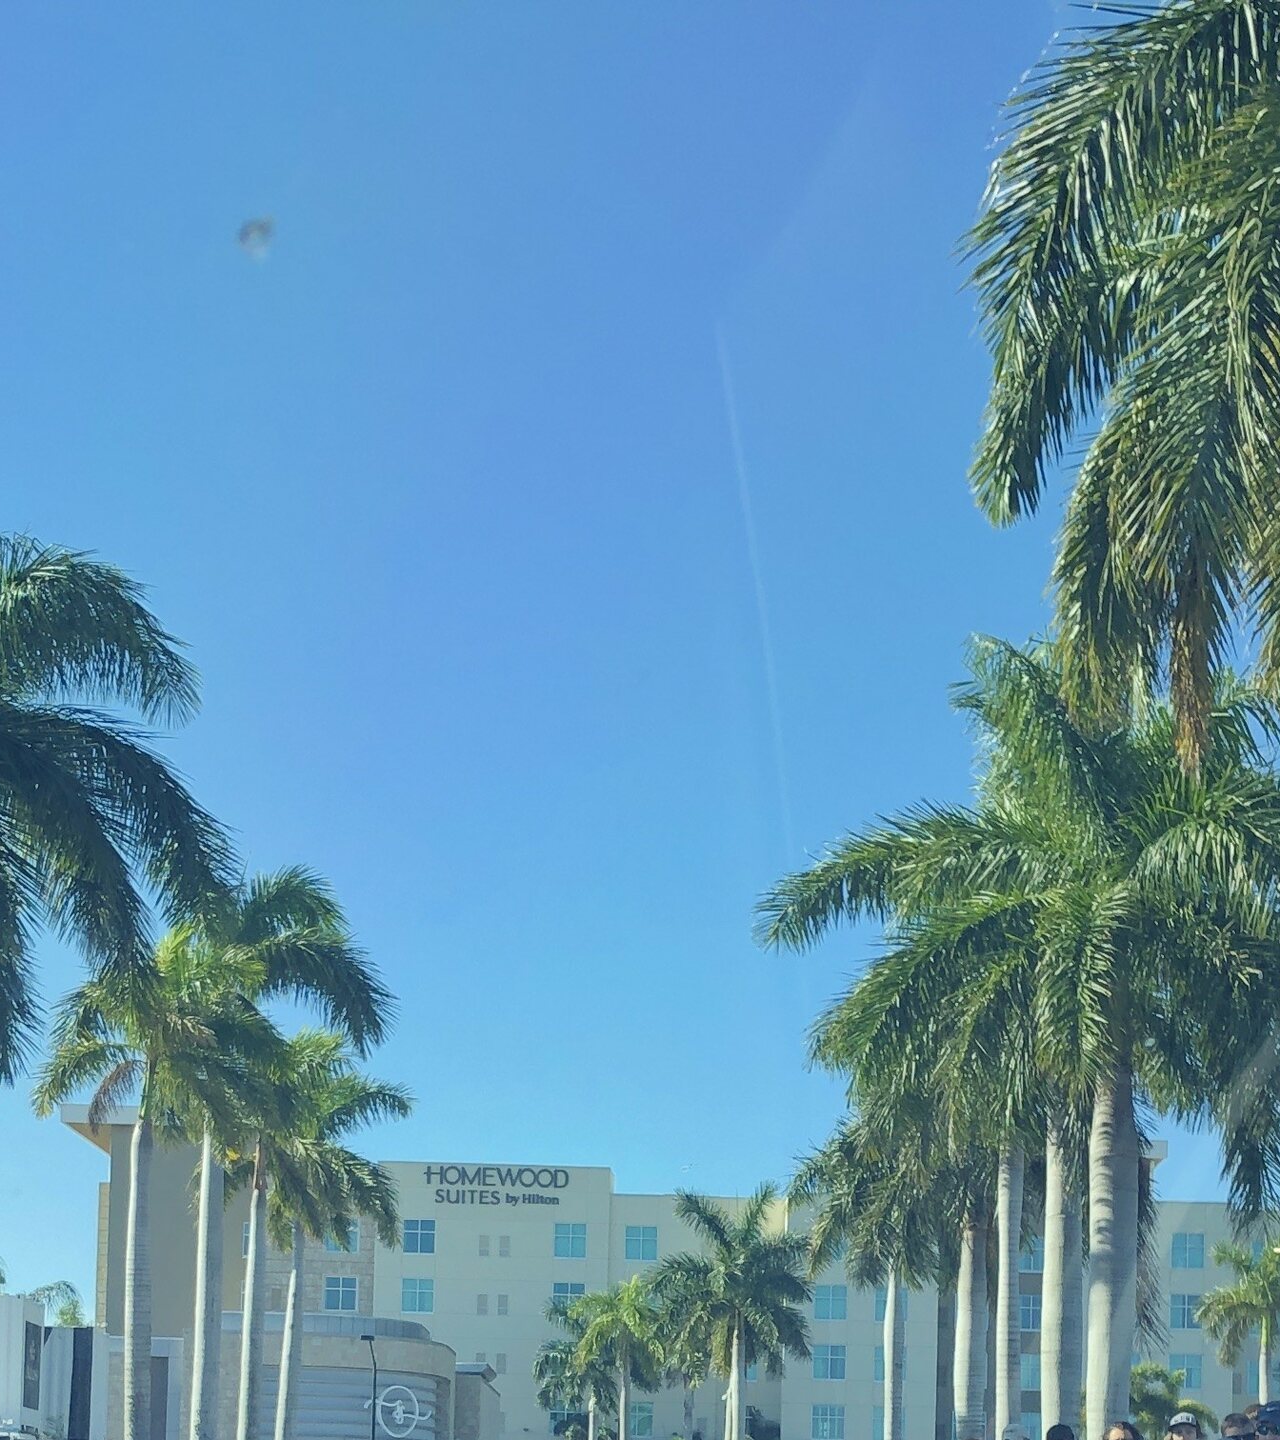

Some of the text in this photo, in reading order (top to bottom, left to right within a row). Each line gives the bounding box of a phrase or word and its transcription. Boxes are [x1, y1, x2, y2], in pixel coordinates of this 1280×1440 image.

[423, 1165, 570, 1189] HOMEWOOD
[434, 1189, 560, 1207] SUITES by Hilton
